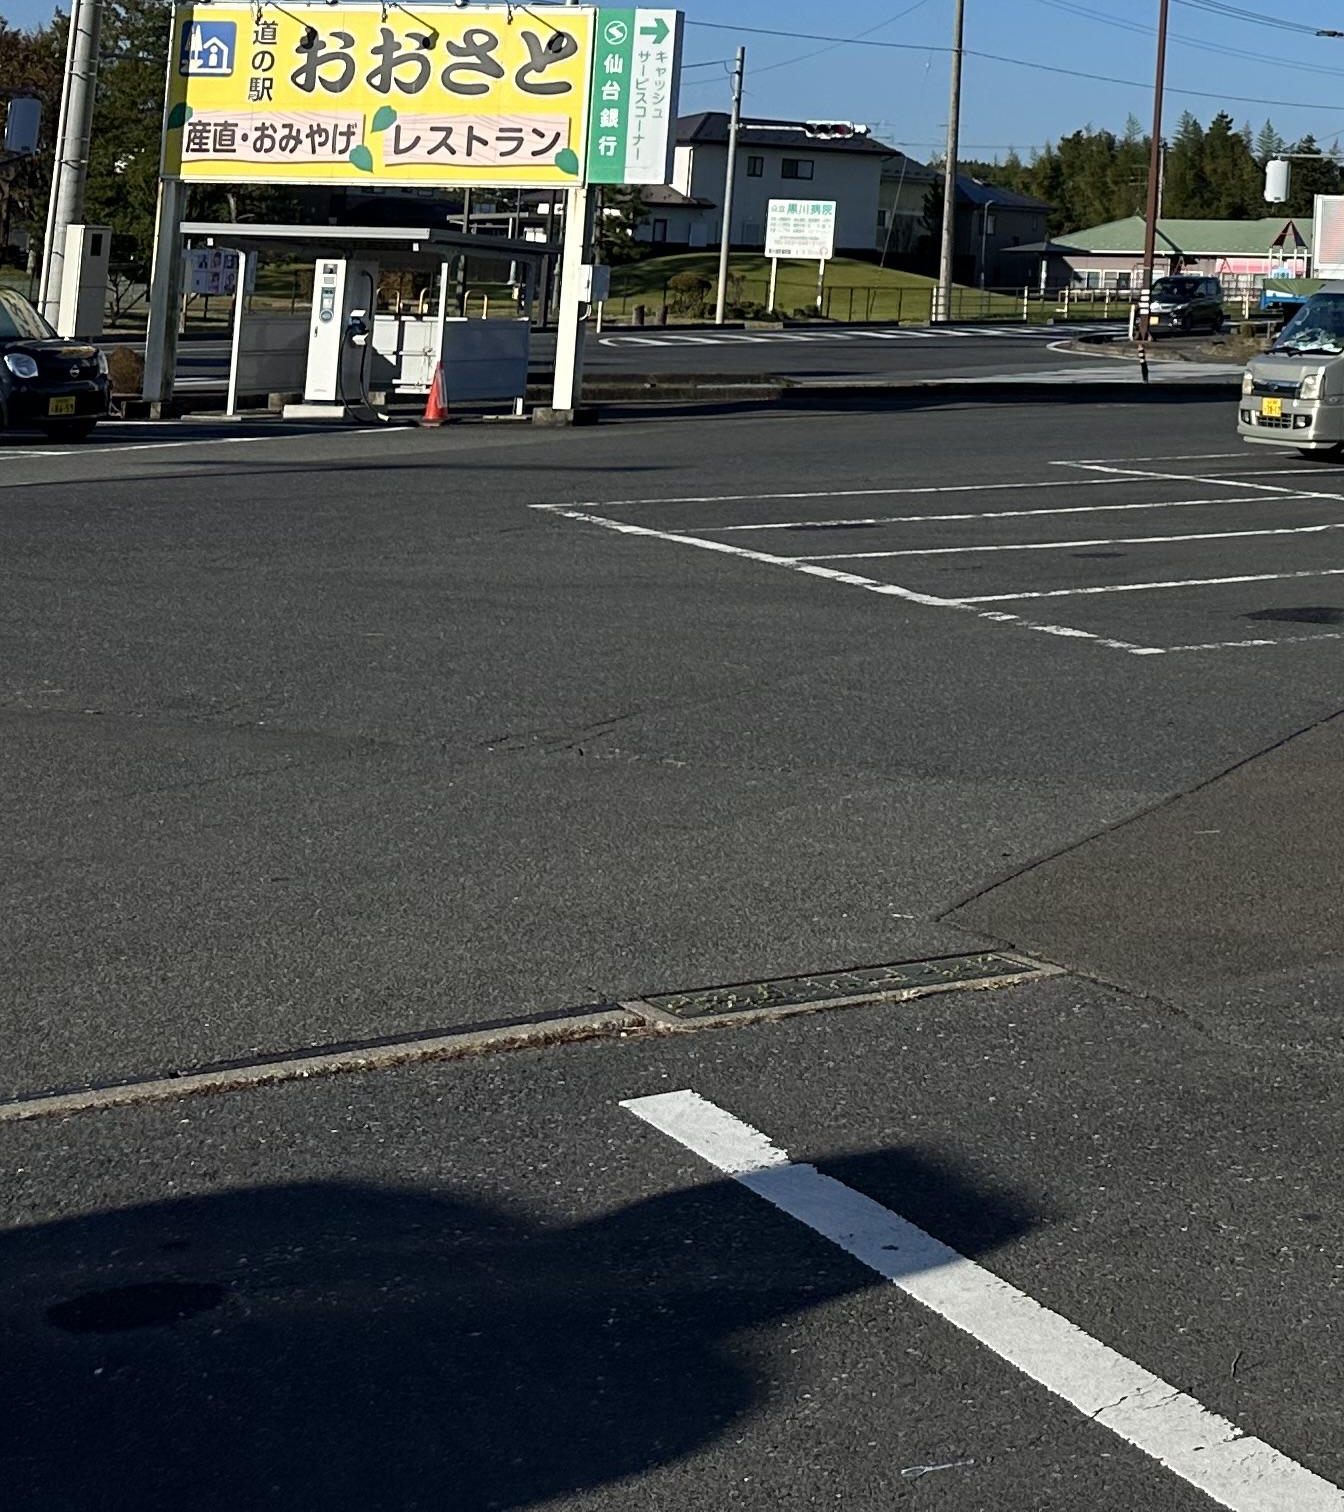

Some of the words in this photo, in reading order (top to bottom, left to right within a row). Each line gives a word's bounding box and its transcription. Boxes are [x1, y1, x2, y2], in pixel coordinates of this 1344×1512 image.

[248, 20, 279, 102] 道の駅
[290, 27, 578, 94] おおさと
[652, 50, 669, 119] キャッシュ
[185, 120, 358, 155] 産直・おみやげ
[598, 53, 624, 157] 仙台銀行
[633, 50, 651, 160] サービスコーナー
[394, 124, 561, 157] レストラン
